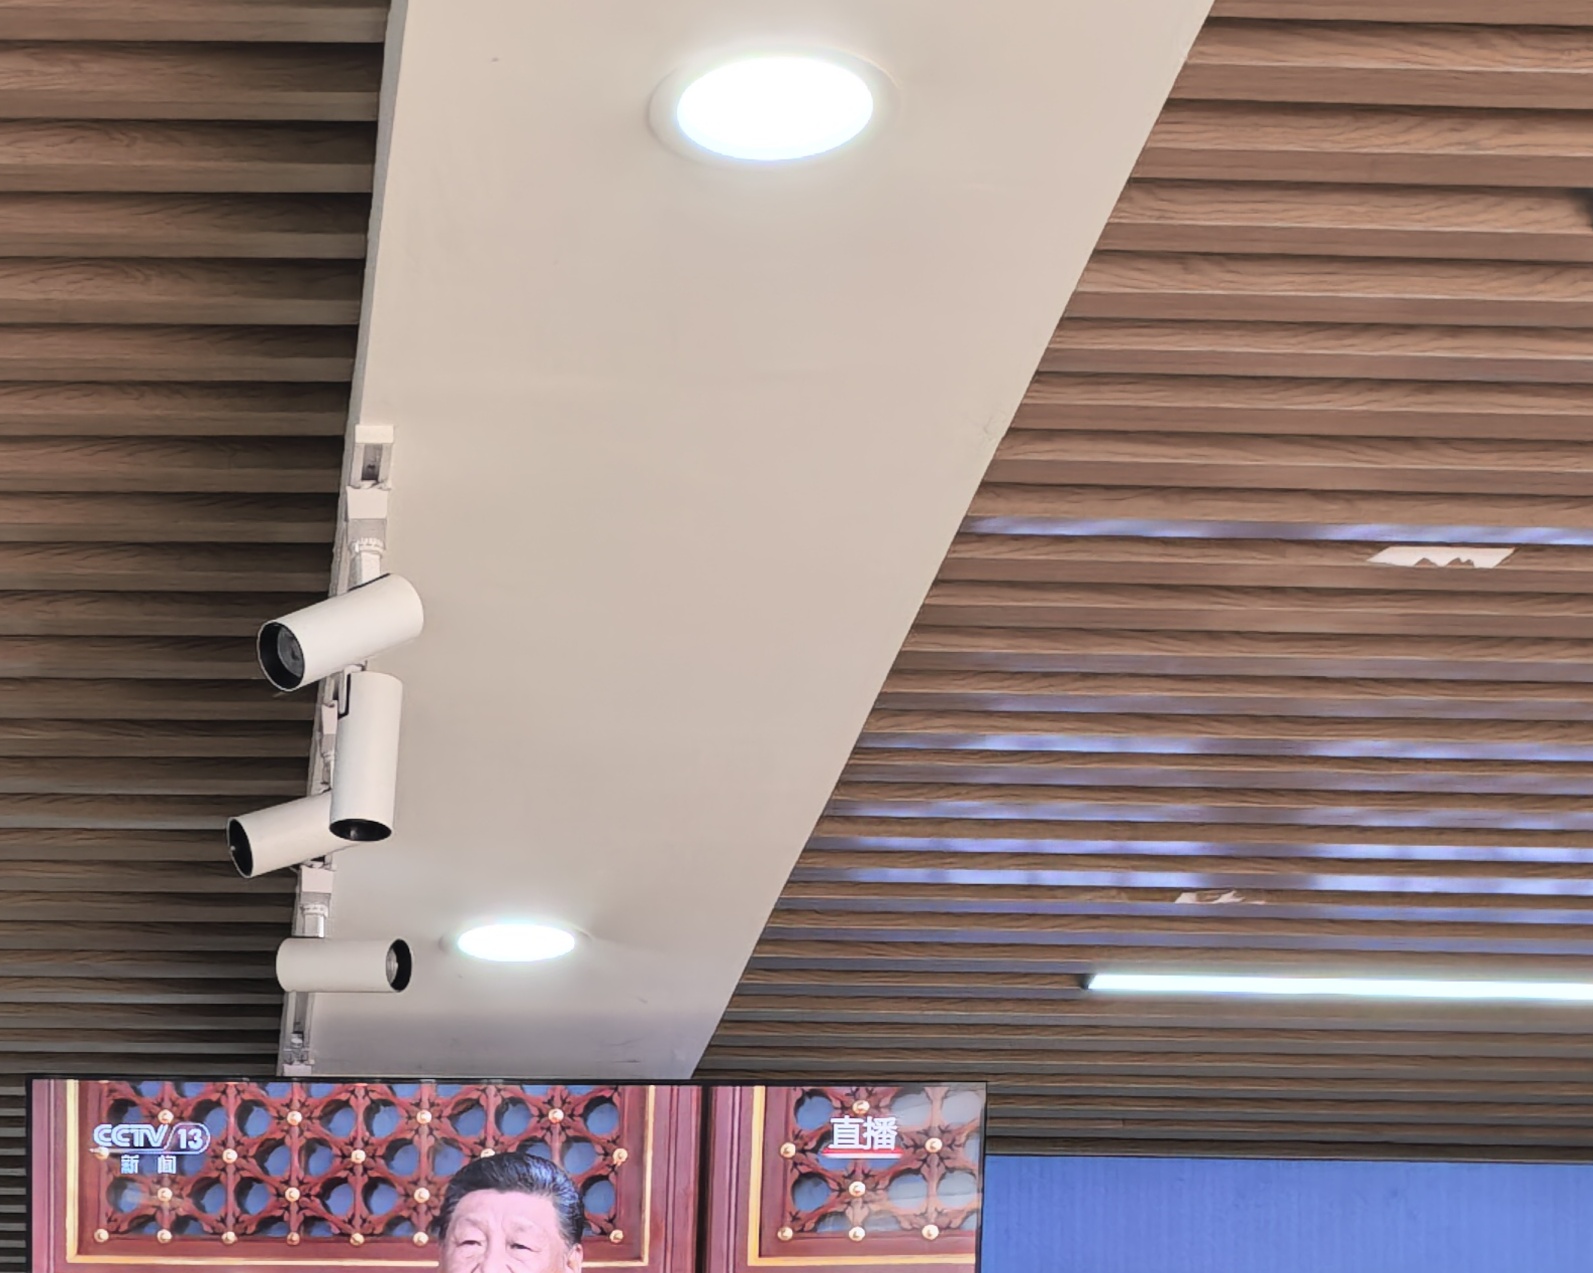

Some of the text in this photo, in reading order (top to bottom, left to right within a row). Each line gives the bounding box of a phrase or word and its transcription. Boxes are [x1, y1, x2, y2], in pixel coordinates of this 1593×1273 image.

[93, 1123, 203, 1149] CCTV 13
[828, 1115, 898, 1150] 直播
[120, 1154, 177, 1174] 新闻
